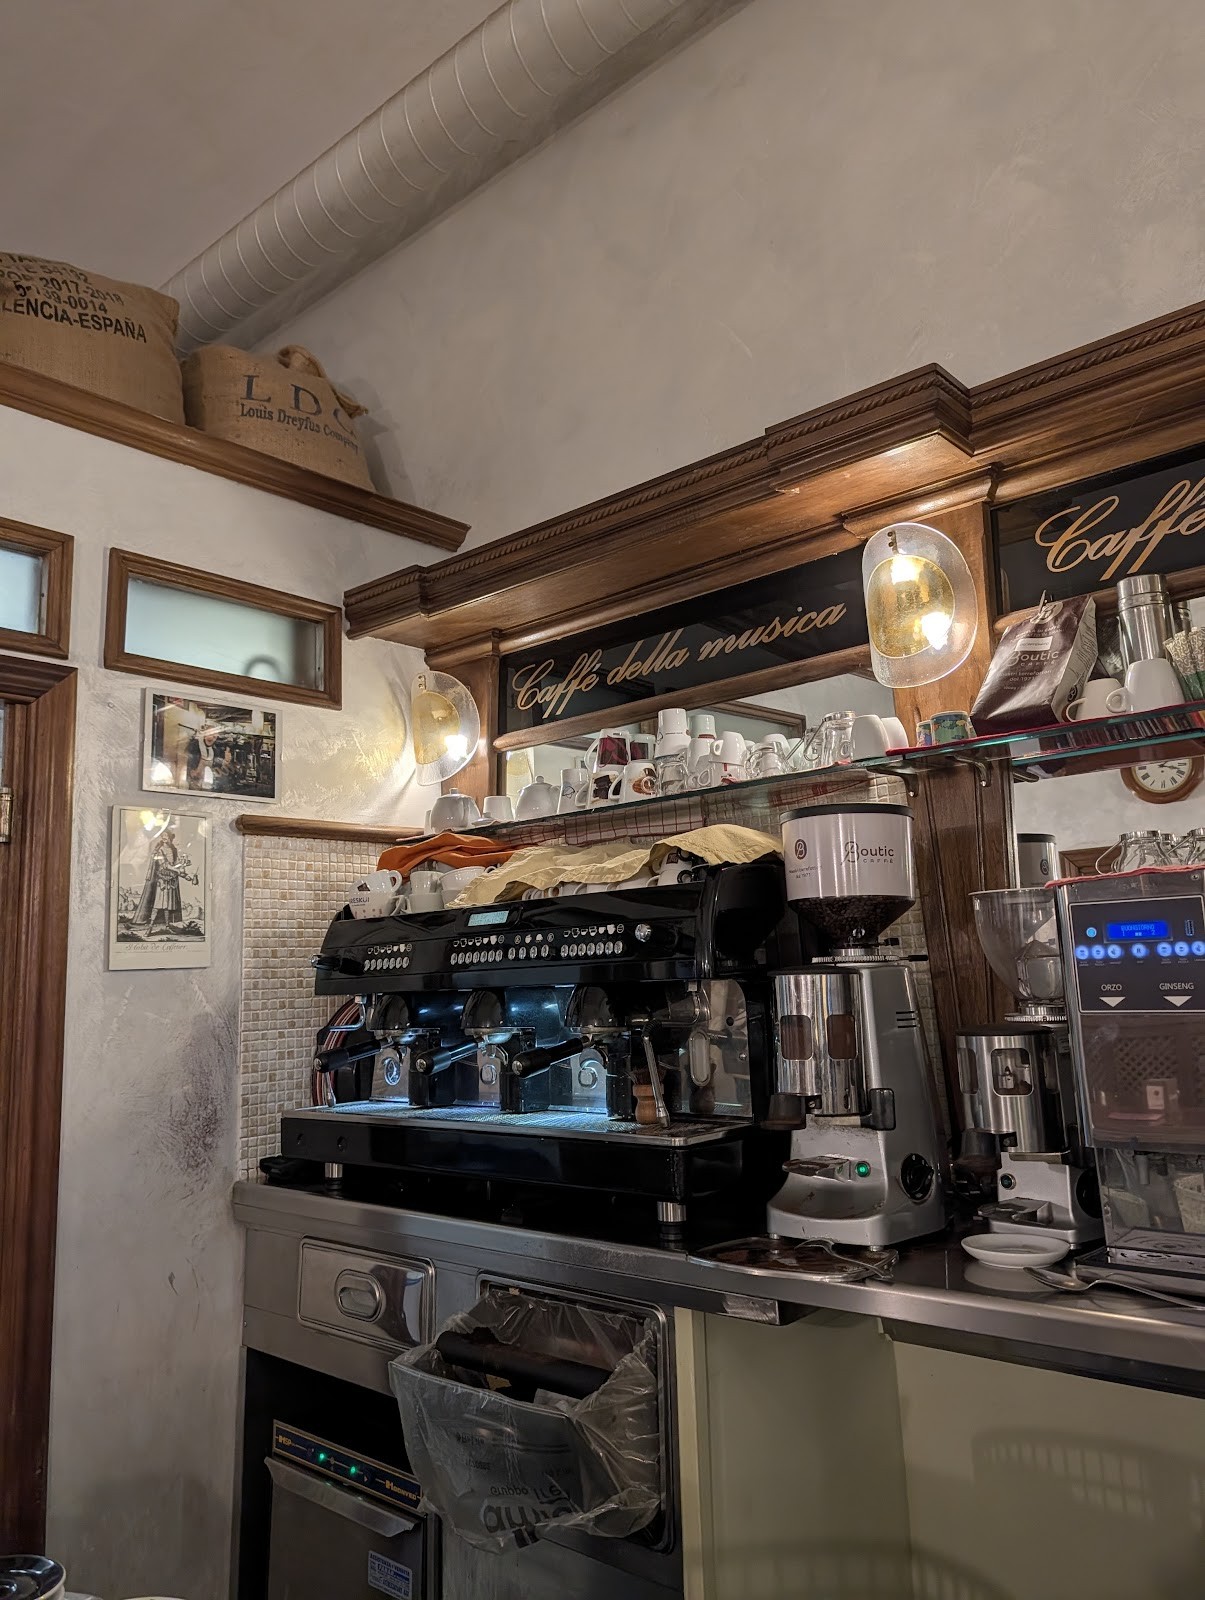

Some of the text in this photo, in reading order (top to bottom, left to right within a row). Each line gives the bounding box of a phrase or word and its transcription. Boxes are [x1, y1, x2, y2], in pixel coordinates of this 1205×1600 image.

[240, 403, 274, 421] Louis
[276, 409, 321, 431] Dreyfus
[606, 628, 690, 686] della
[697, 602, 847, 662] musica
[840, 841, 894, 865] Boutic
[1159, 982, 1195, 990] GINSENG
